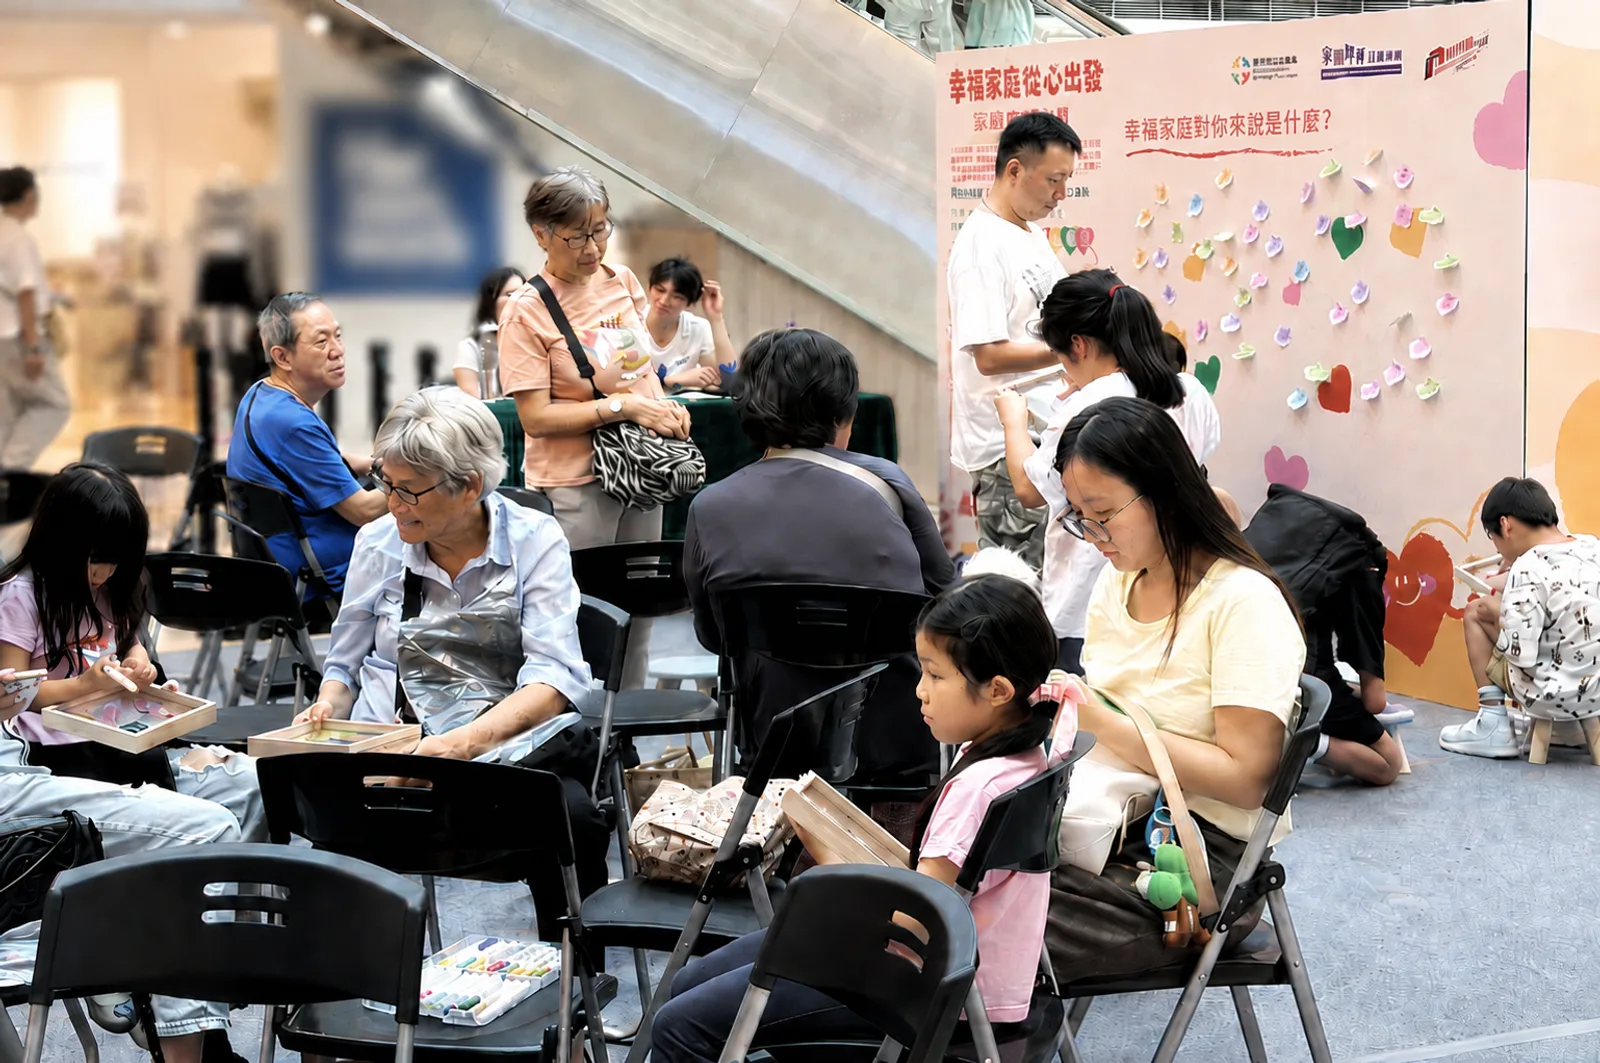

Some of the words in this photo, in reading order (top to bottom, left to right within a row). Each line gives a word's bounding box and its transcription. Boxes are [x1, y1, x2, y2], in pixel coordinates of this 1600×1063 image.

[949, 59, 1104, 104] 幸福家庭從心出發
[1124, 108, 1332, 142] 幸福家庭對你來說是什麼?
